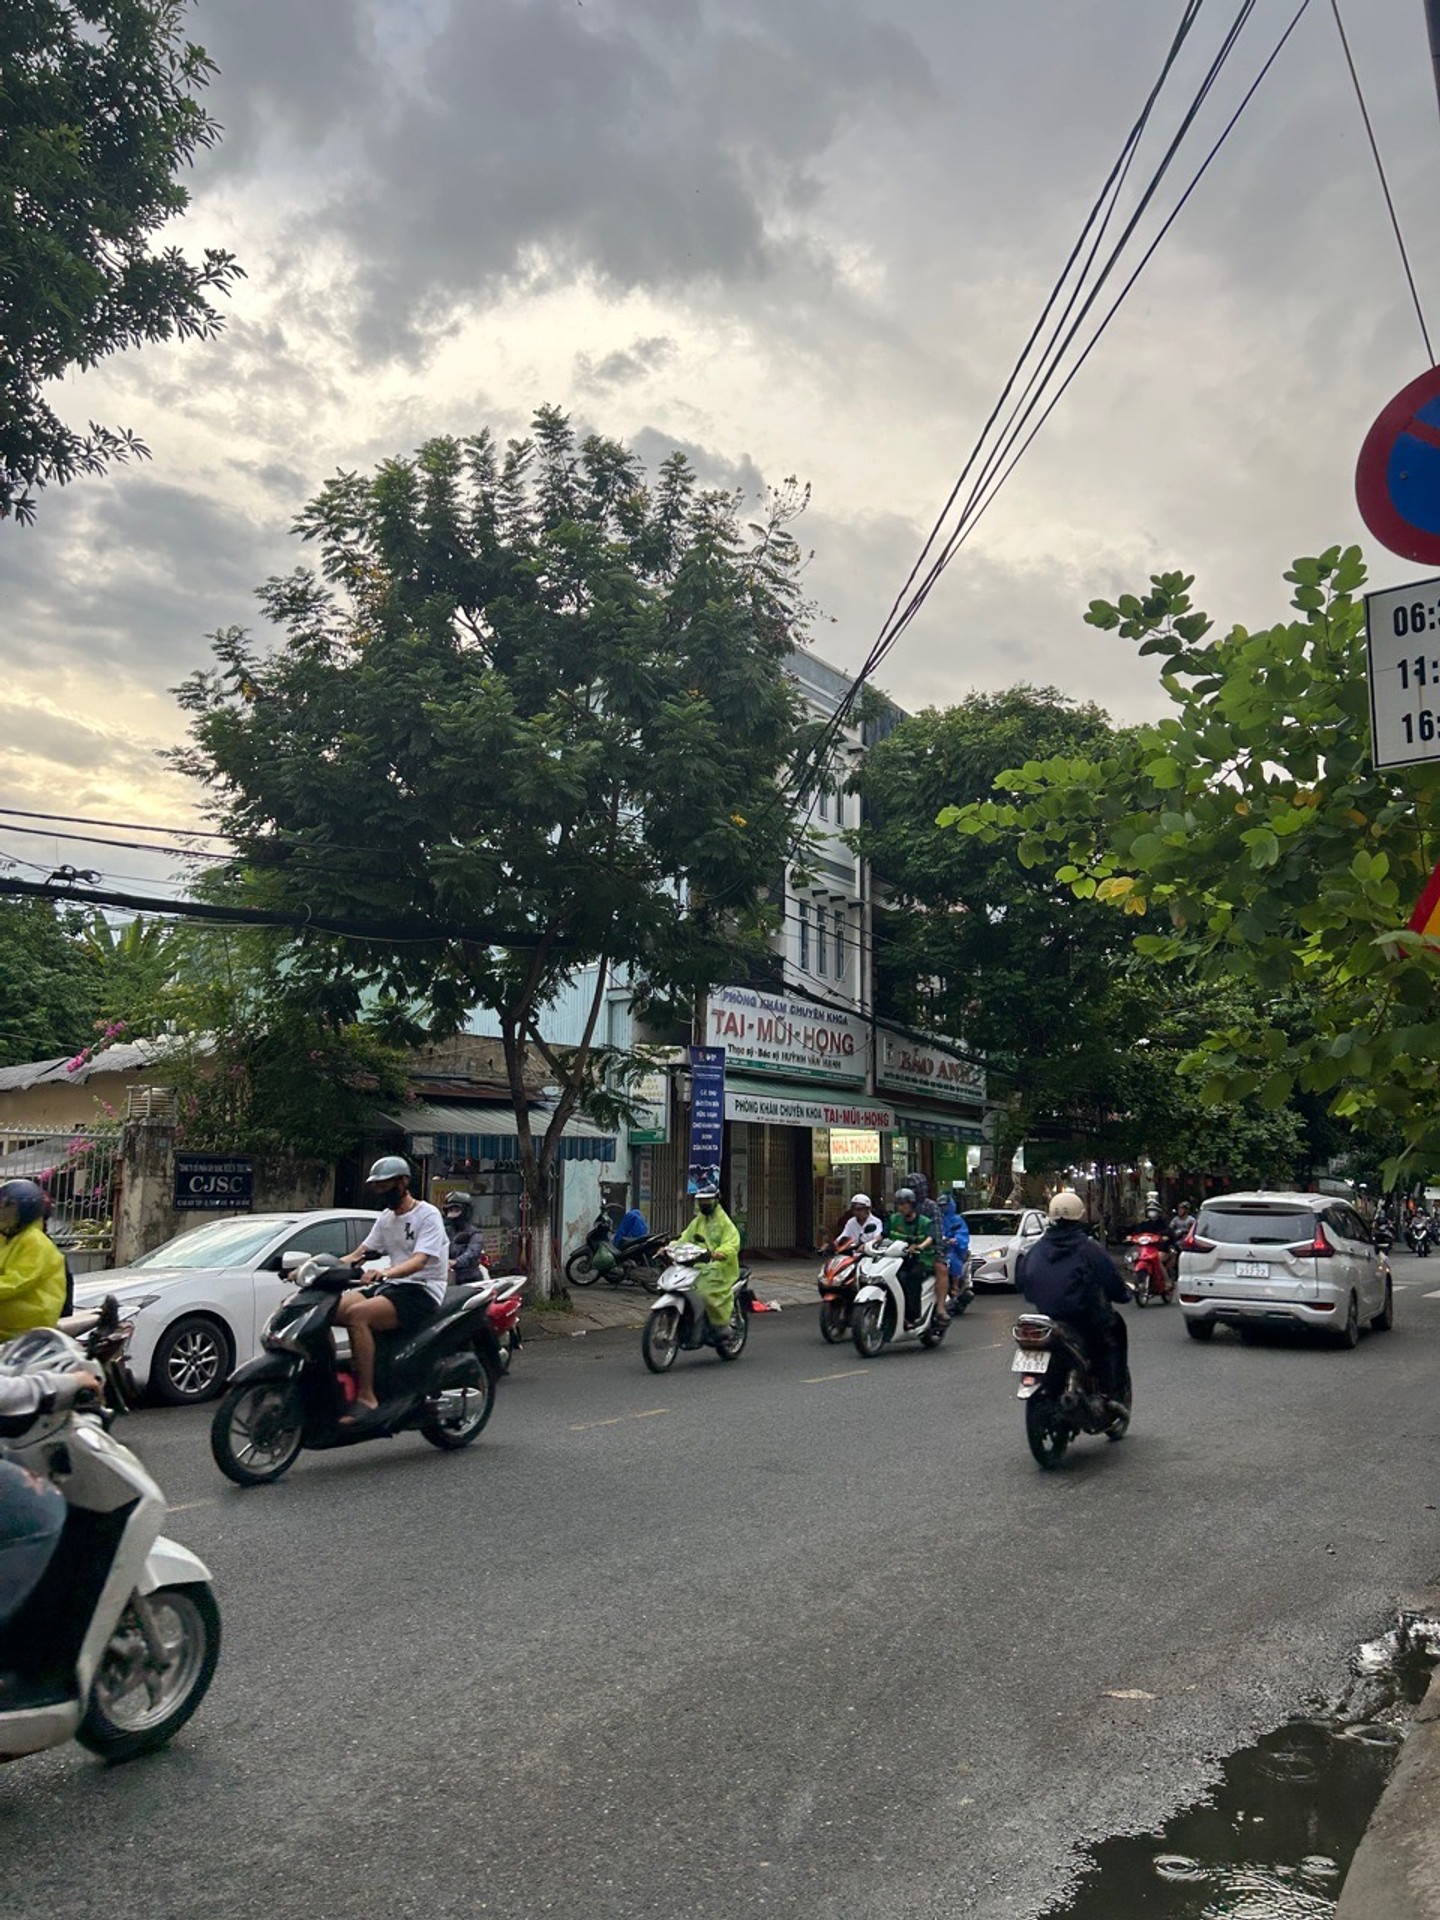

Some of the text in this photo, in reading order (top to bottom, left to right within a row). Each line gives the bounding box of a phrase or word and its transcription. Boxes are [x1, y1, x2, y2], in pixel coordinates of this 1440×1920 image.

[1393, 599, 1440, 637] 06:
[790, 1003, 826, 1021] CHUYÊN
[826, 1012, 849, 1025] KHOA
[734, 1097, 759, 1113] PHÒNG
[760, 1101, 779, 1116] KHÁM
[780, 1103, 805, 1118] CHUYÊN
[806, 1107, 822, 1120] KHOA
[832, 1134, 849, 1154] NHÀ
[849, 1133, 878, 1154] THUỐC
[189, 1175, 243, 1193] CJSC
